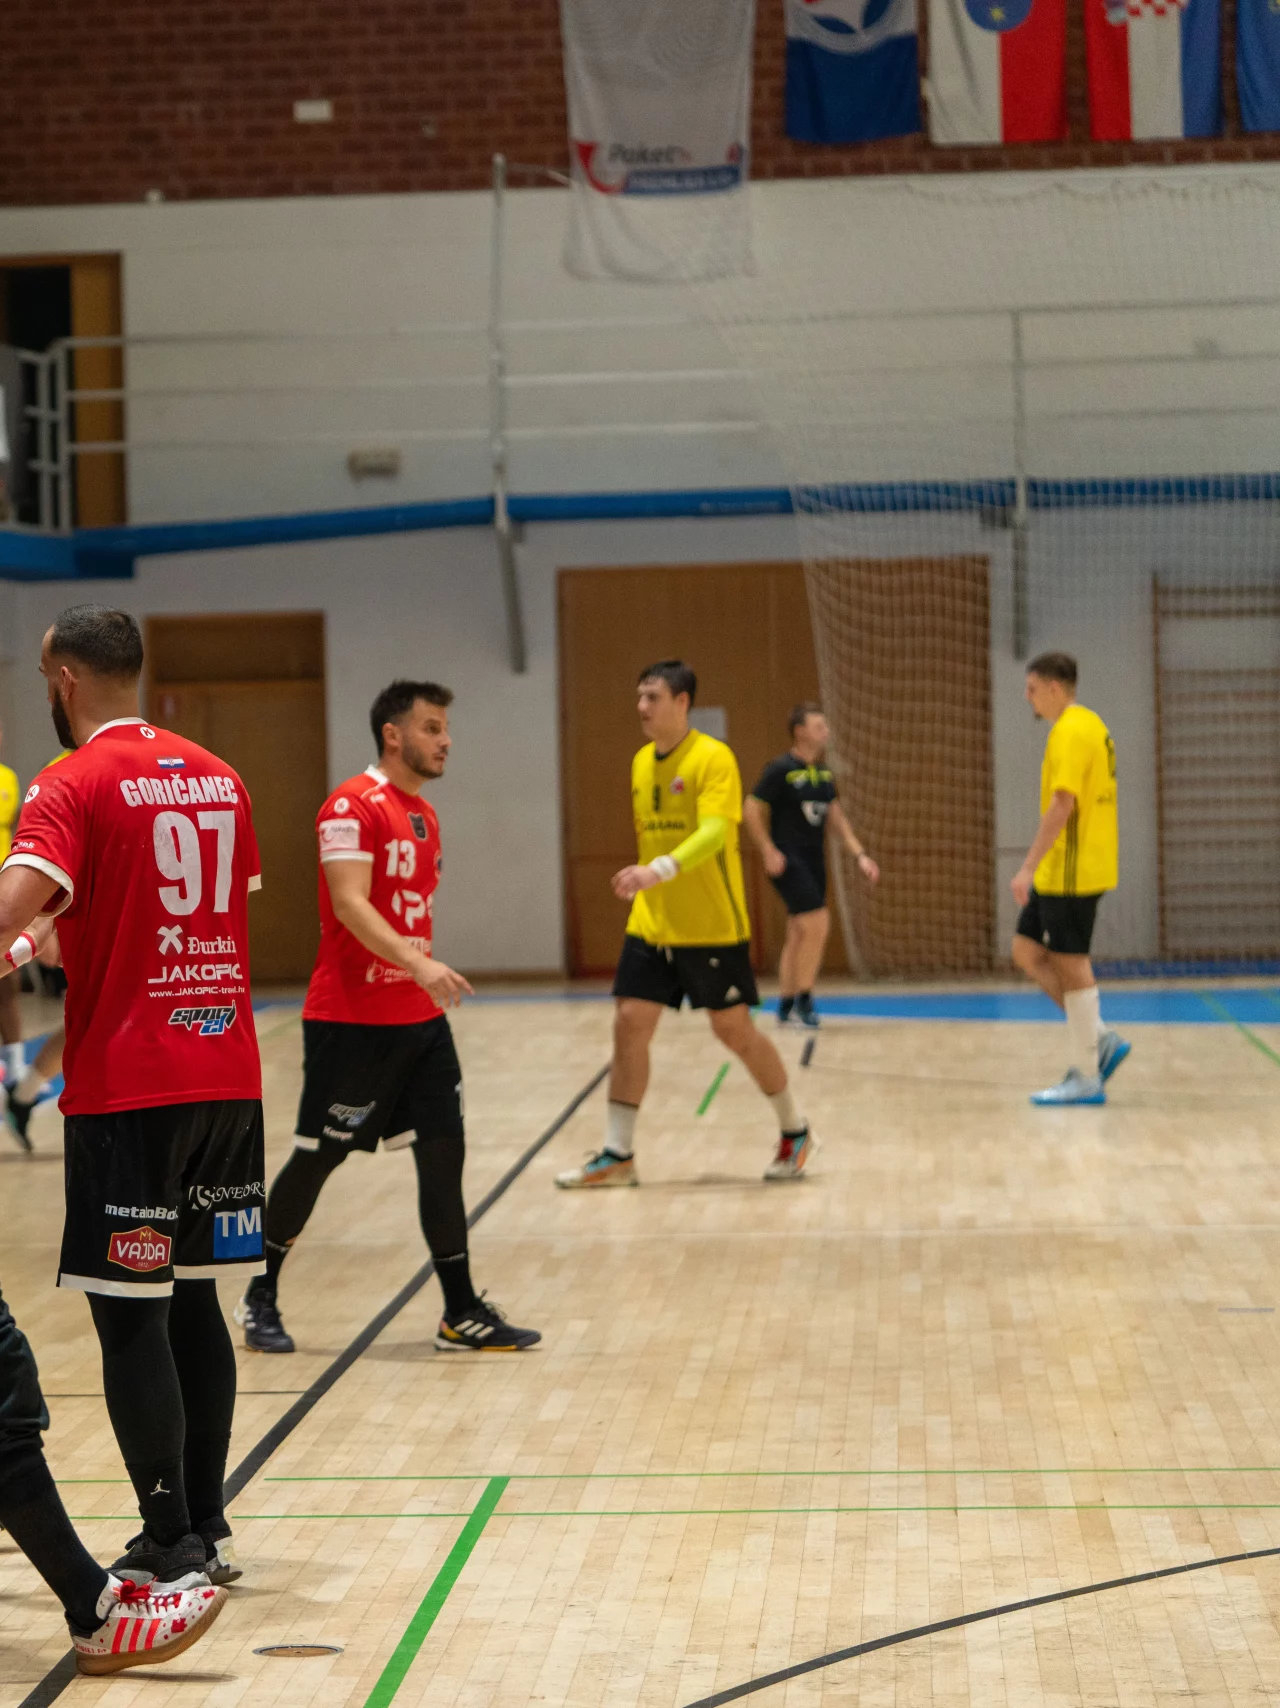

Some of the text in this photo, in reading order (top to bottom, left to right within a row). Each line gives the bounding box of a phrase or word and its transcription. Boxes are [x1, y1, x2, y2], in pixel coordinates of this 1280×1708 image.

[120, 774, 238, 807] GORIČANEC
[153, 810, 236, 916] 97
[384, 838, 416, 879] 13
[215, 1207, 261, 1238] TM
[116, 1240, 166, 1261] VAJDA
